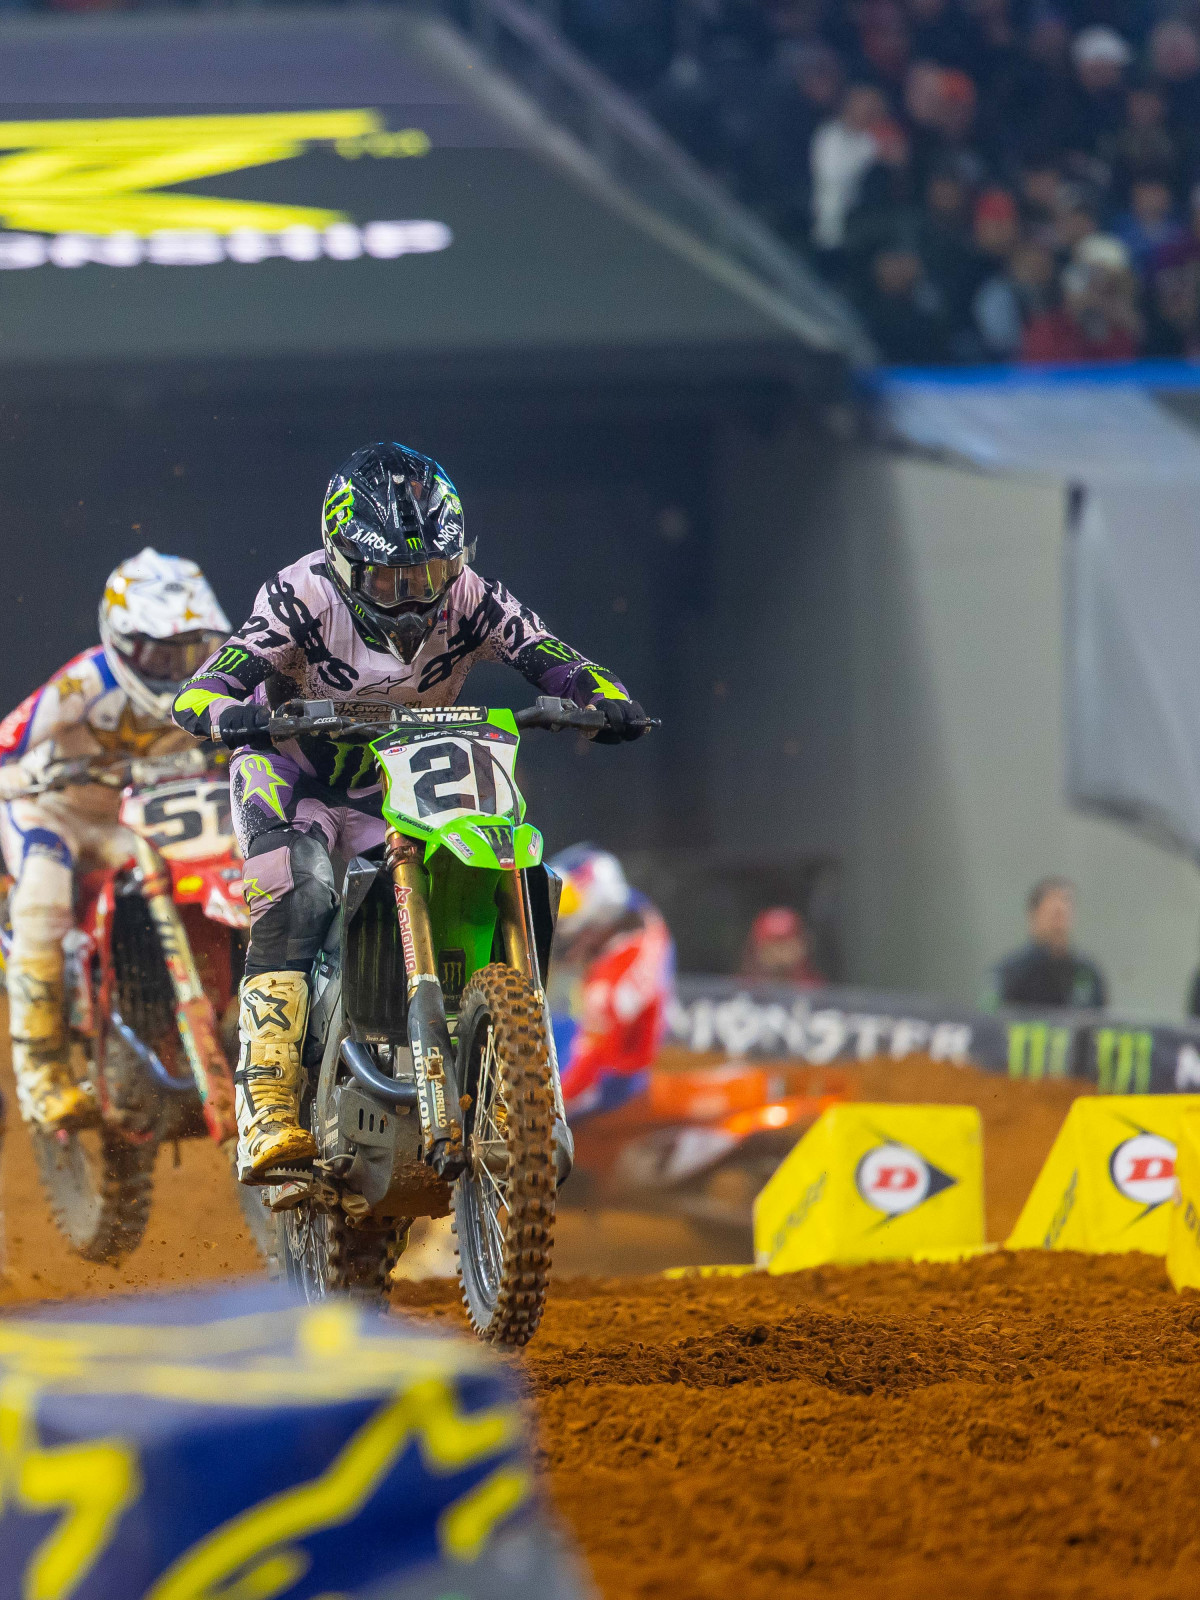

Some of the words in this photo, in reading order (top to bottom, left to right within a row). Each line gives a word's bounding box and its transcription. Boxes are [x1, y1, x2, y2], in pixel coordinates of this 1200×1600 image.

[409, 742, 496, 818] 21
[144, 788, 233, 848] 51
[396, 813, 434, 833] Kawasaki
[397, 907, 417, 975] SHOWA
[871, 1165, 919, 1191] D
